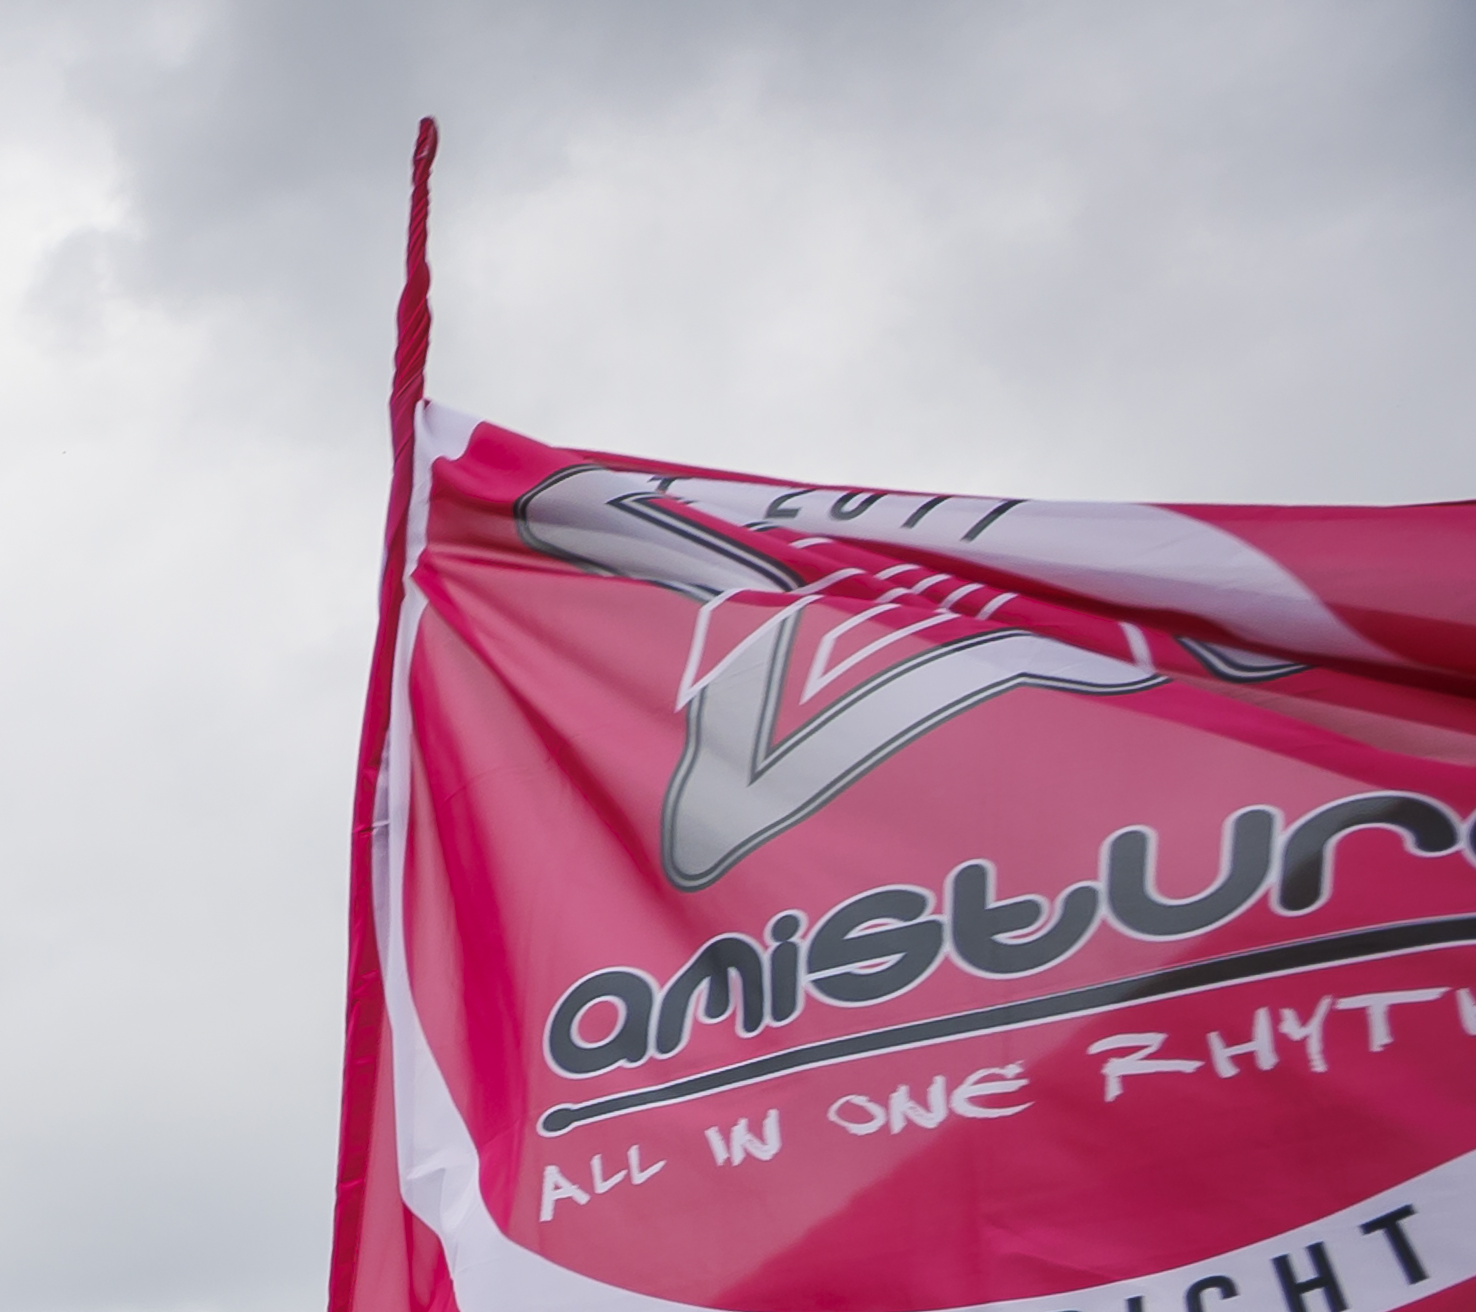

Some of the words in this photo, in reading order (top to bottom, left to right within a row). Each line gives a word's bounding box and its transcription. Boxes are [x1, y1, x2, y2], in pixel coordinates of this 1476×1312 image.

[544, 790, 1476, 1078] amistur
[539, 1143, 668, 1222] ALL
[705, 1107, 783, 1167] IN
[828, 1060, 1036, 1136] ONE
